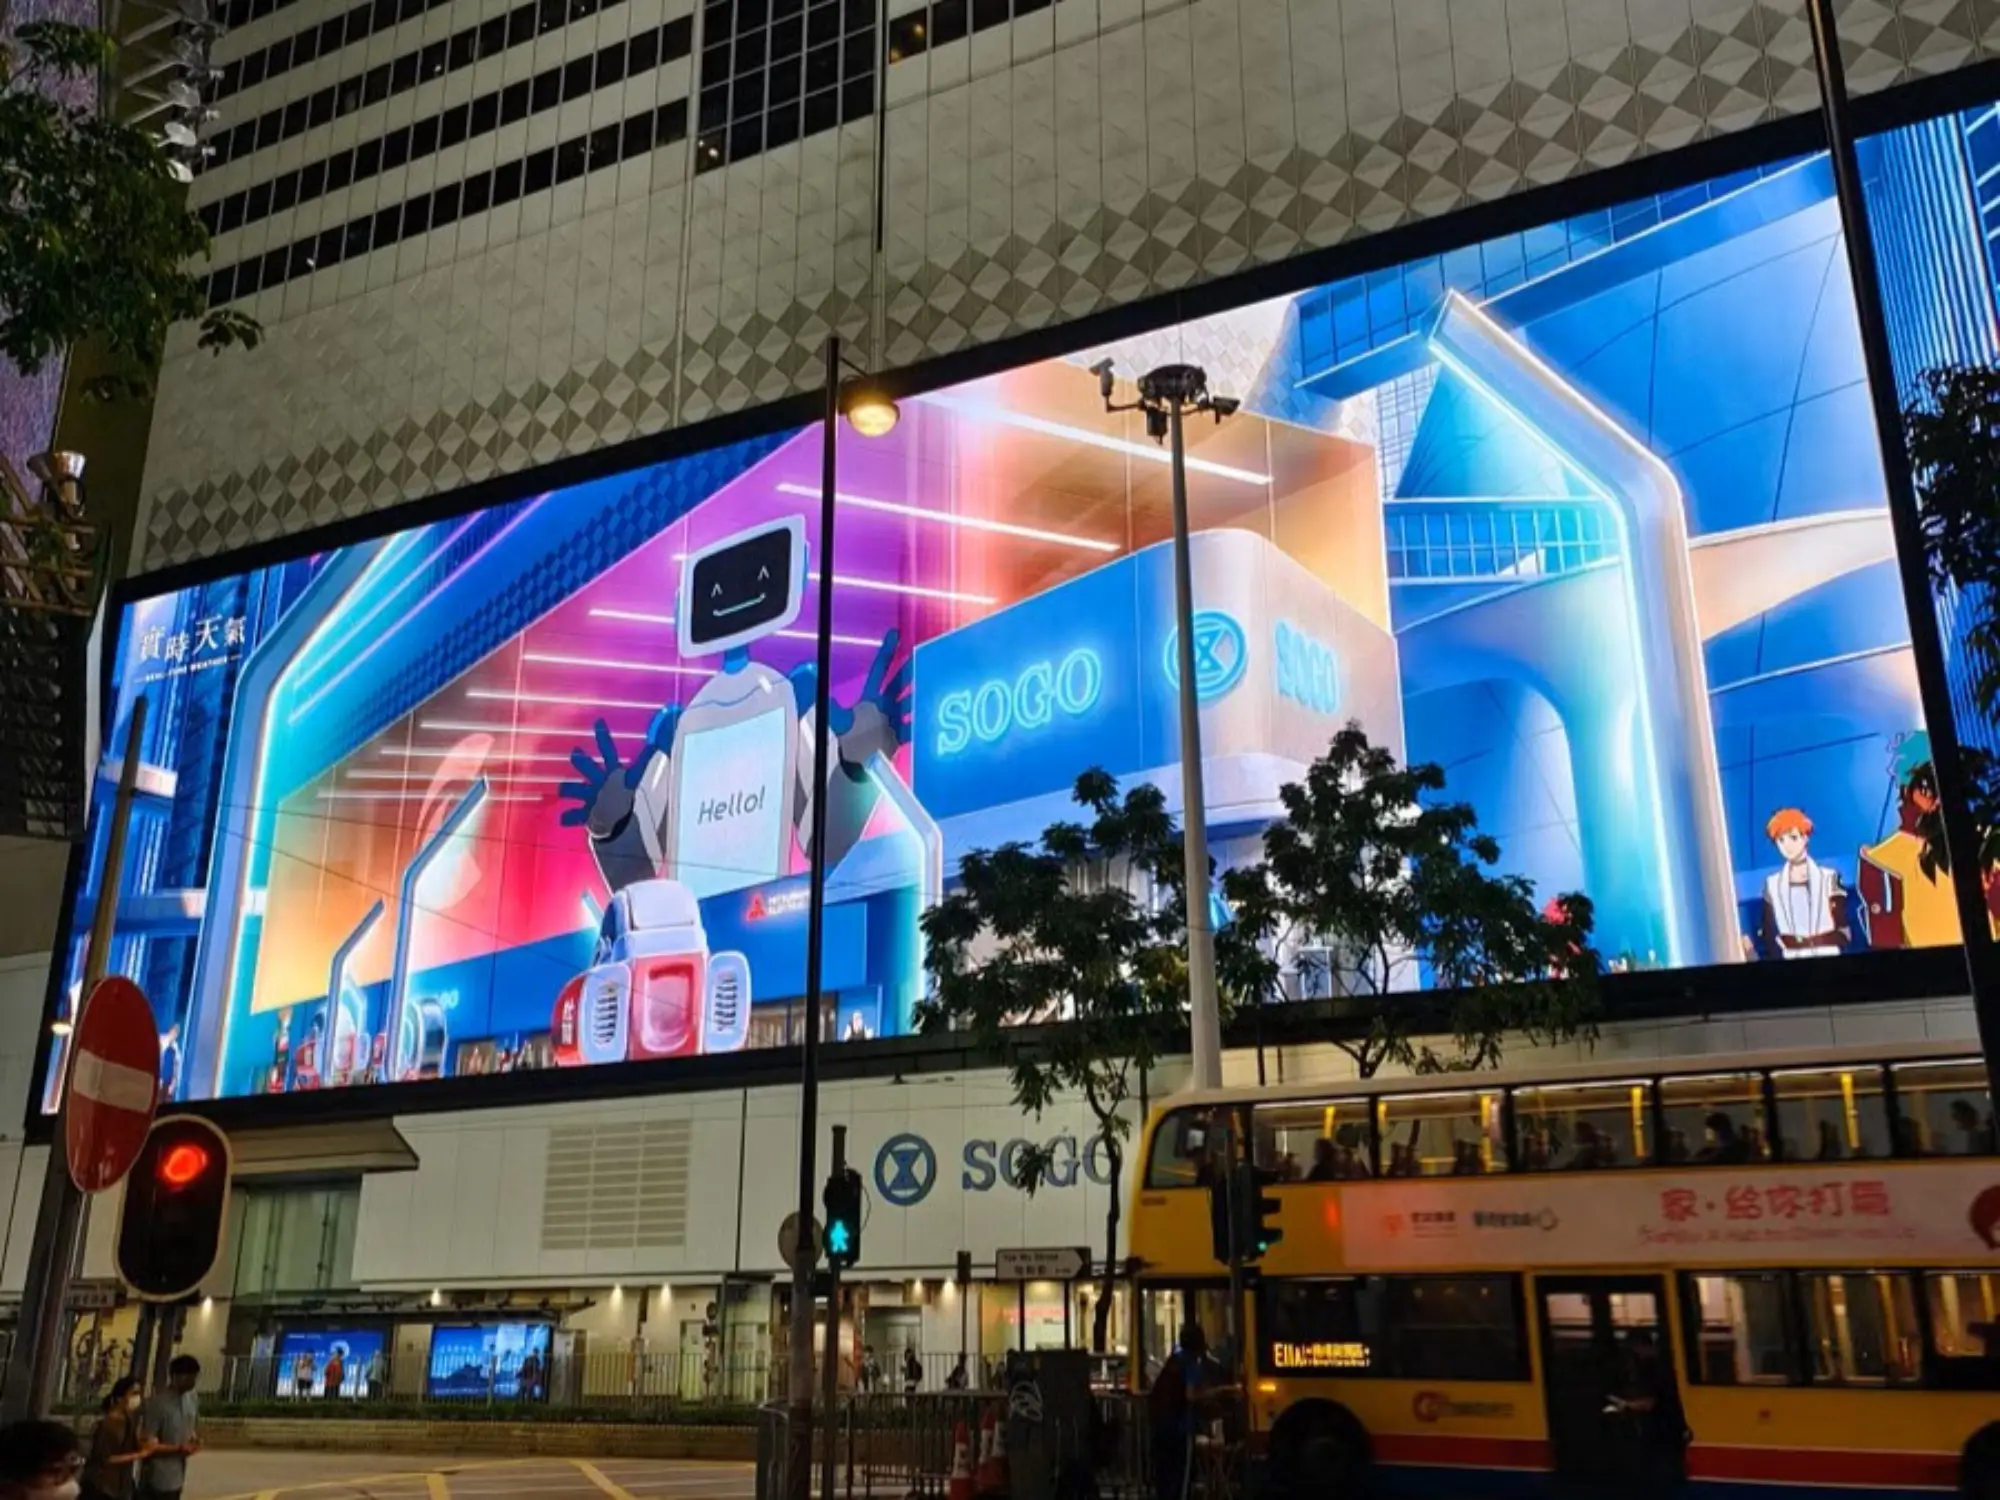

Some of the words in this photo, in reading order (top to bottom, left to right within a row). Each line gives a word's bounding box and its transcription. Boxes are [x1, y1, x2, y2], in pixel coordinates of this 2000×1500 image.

[937, 647, 1101, 756] SOGO
[1275, 619, 1340, 715] SOGO
[697, 784, 766, 826] Hello!
[961, 1134, 1123, 1192] SOGO
